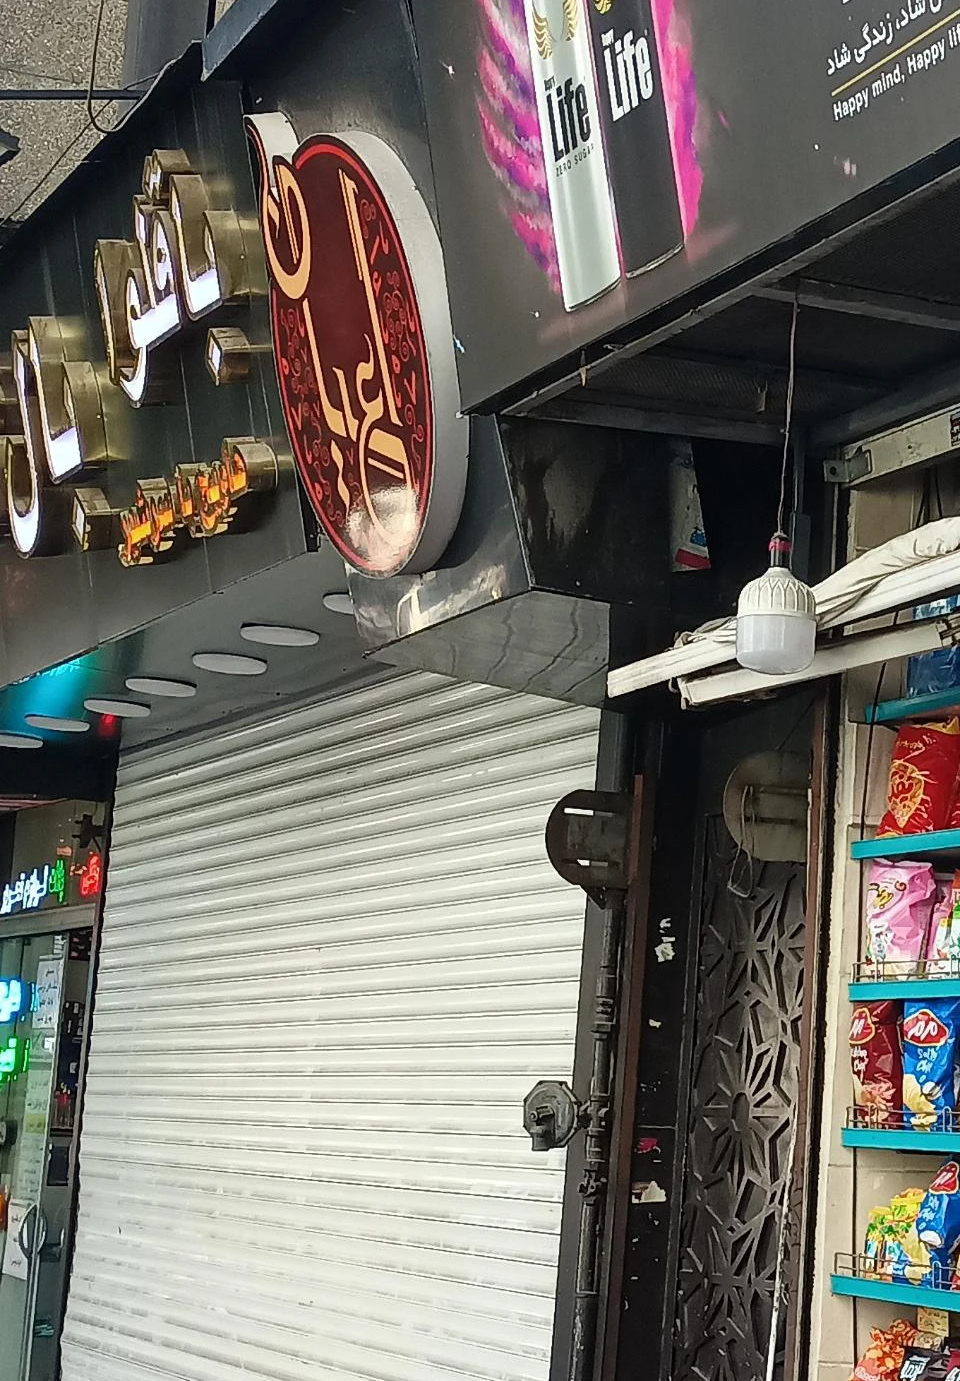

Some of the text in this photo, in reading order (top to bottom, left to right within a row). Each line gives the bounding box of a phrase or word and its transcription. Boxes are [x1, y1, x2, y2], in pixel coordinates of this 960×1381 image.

[603, 29, 654, 121] Life
[826, 46, 851, 76] شاد
[854, 12, 893, 65] زندگی
[545, 77, 592, 163] Life
[833, 92, 870, 122] Happy
[871, 67, 906, 100] mind,
[907, 39, 946, 77] Happy
